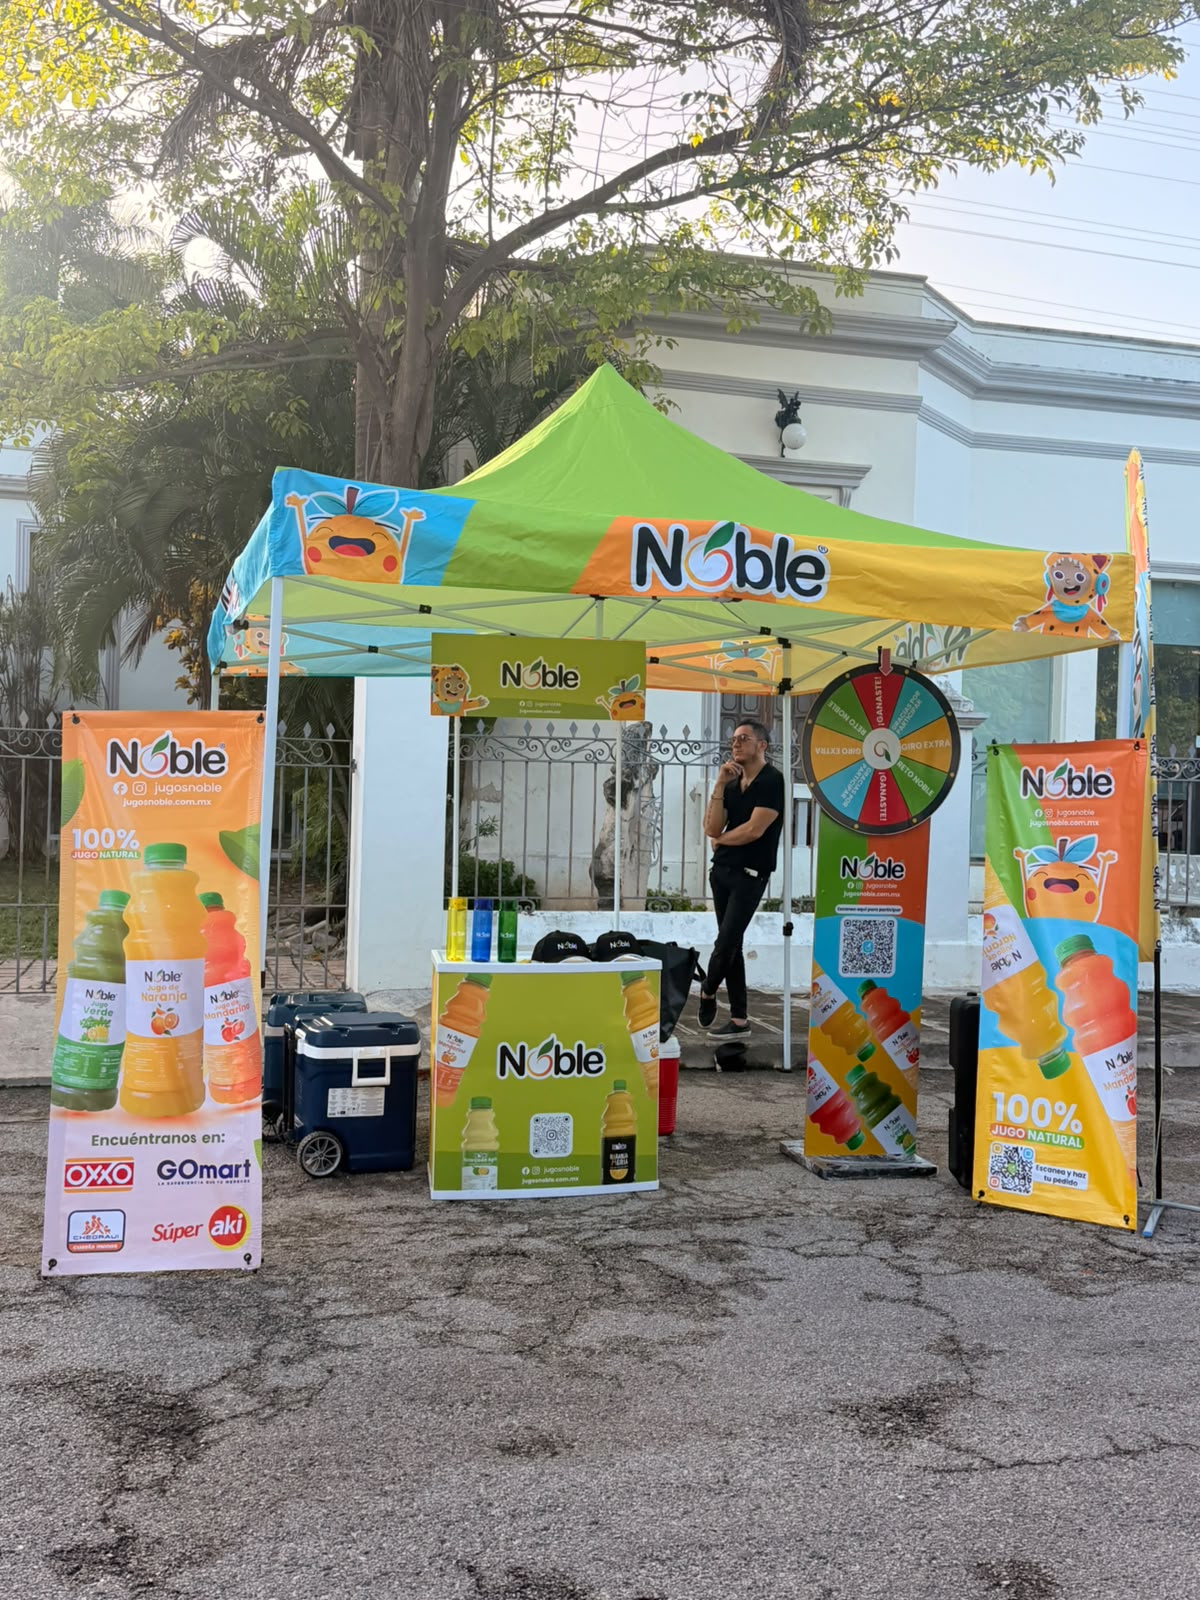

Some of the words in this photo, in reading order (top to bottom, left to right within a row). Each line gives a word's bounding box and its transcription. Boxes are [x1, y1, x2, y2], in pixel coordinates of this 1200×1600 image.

[828, 700, 849, 721] NOBLE
[849, 718, 867, 736] RETO
[815, 747, 841, 755] EXTRA
[901, 741, 923, 751] GIRO
[924, 739, 950, 749] EXTRA
[108, 733, 227, 777] Noble
[897, 760, 914, 778] RETO
[912, 775, 935, 797] NOBLE
[1021, 760, 1114, 798] Noble
[154, 782, 222, 795] jugosnoble
[1056, 808, 1095, 818] jugosnoble
[72, 828, 139, 849] 100%
[72, 851, 98, 859] JUGO
[100, 850, 139, 859] NATURAL
[841, 854, 905, 879] Noble
[140, 991, 187, 1004] Naranja
[146, 985, 166, 993] Jugo
[83, 1006, 114, 1017] Verde
[204, 1003, 250, 1019] Mandarina
[498, 1037, 605, 1078] Noble
[992, 1091, 1083, 1135] 100%
[91, 1131, 197, 1147] Encuéntranos
[201, 1132, 226, 1144] en:
[991, 1125, 1025, 1139] JUGO
[1027, 1130, 1082, 1149] NATURAL
[66, 1162, 133, 1188] OXXO
[157, 1159, 251, 1180] GOmart
[543, 1165, 580, 1175] jugosnoble
[1035, 1164, 1066, 1176] Escanea
[1066, 1170, 1072, 1178] y
[1072, 1170, 1086, 1179] haz
[1053, 1177, 1078, 1187] pedido
[152, 1222, 204, 1243] Súper
[210, 1213, 244, 1236] aki
